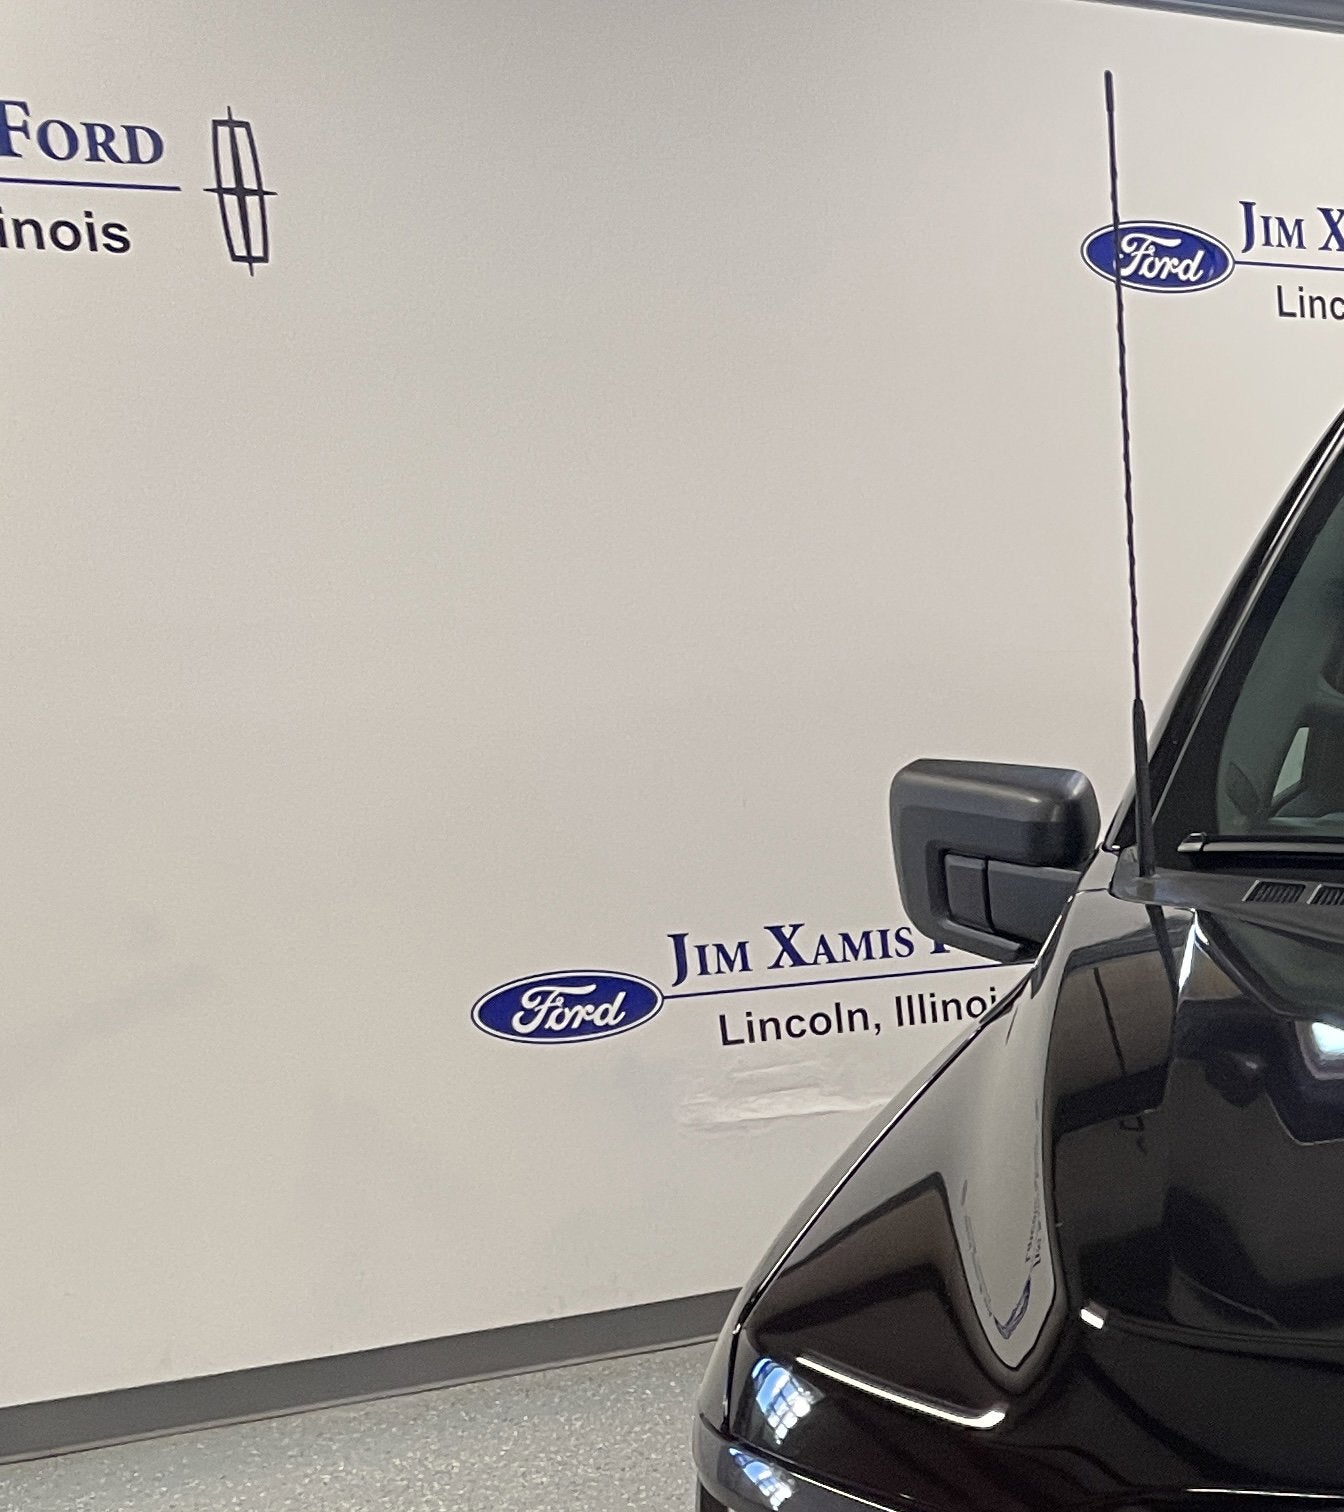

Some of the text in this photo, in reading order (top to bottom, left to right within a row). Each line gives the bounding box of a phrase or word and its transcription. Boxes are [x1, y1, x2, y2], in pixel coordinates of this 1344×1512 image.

[0, 100, 164, 164] FORD
[1239, 200, 1307, 254] JIM
[1120, 233, 1204, 282] Ford
[667, 923, 915, 987] JIM XAMIS
[511, 984, 626, 1035] Ford
[719, 986, 997, 1047] Lincoln, Illinoi
